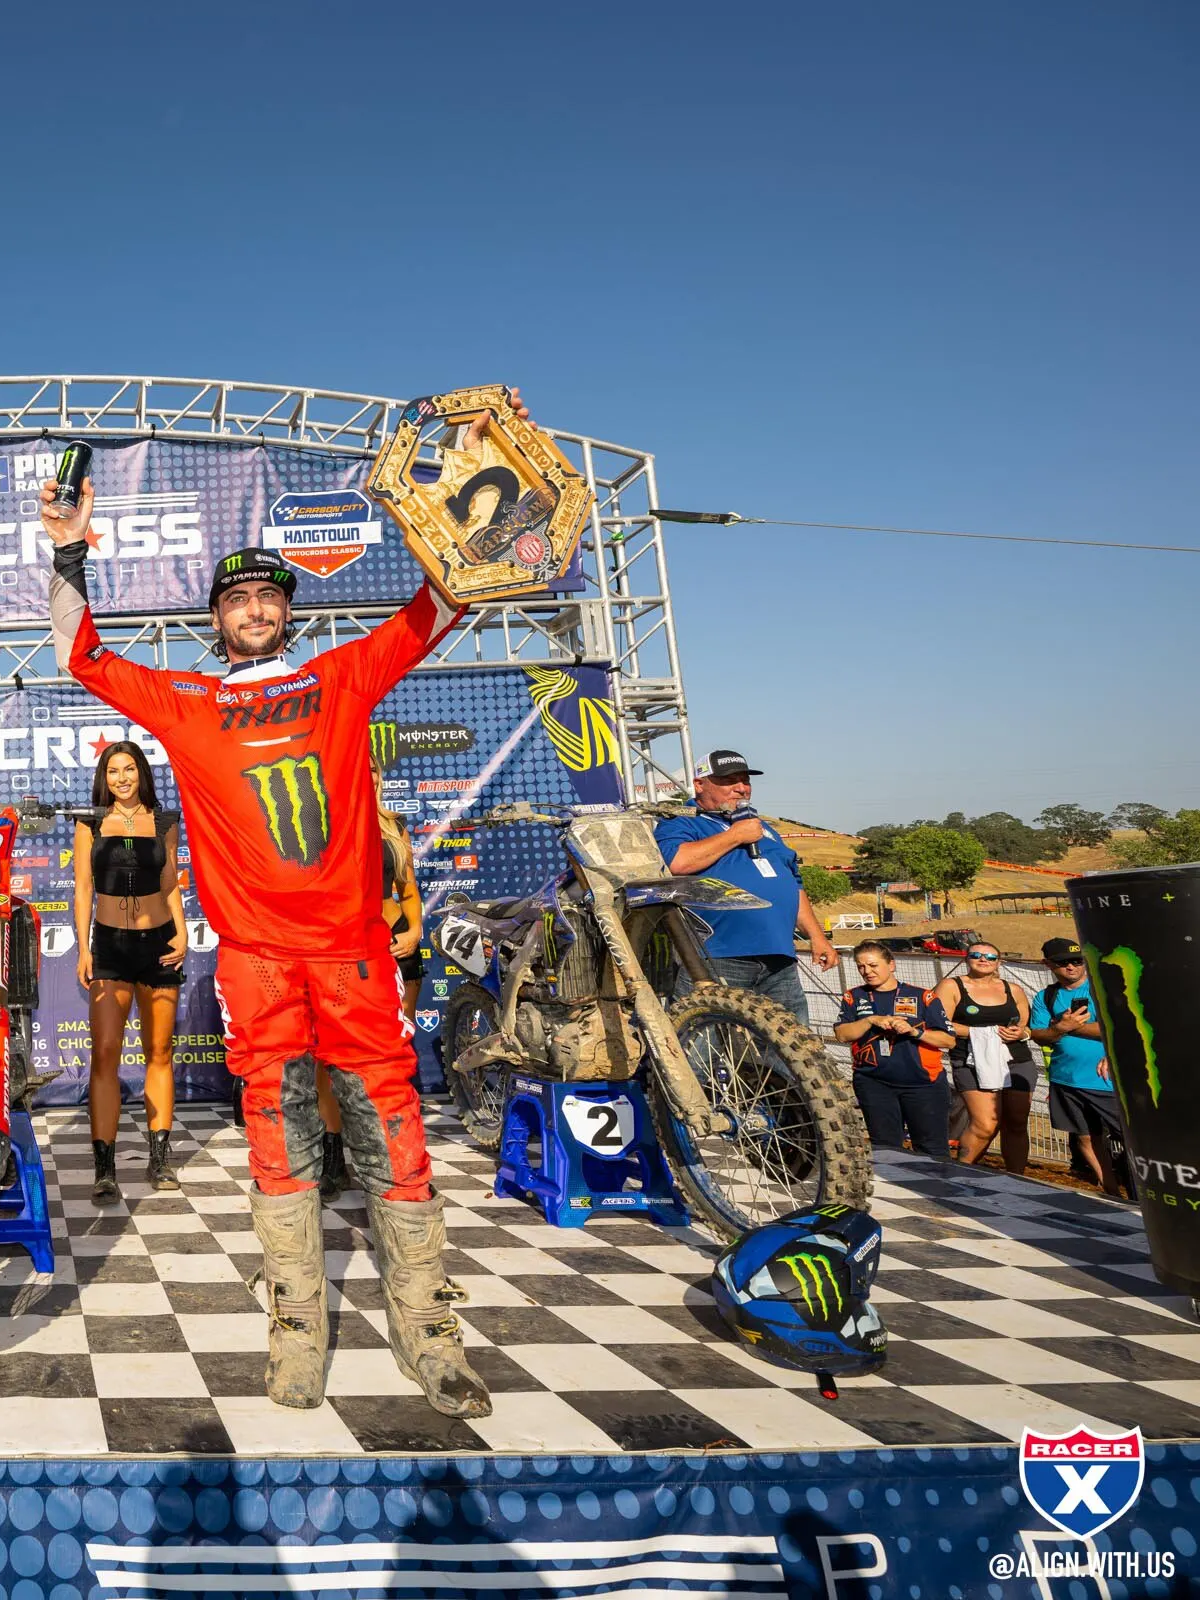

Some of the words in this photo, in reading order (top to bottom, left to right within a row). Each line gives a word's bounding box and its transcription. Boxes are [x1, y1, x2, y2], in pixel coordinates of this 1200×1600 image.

[298, 505, 341, 514] CARSON
[341, 503, 365, 512] CITY
[284, 527, 360, 544] HANGTOWN
[285, 549, 329, 557] MOTOCROSS
[331, 547, 362, 555] CLASSIC
[233, 571, 271, 582] YAMAHA
[281, 675, 317, 692] YAMAHA
[220, 688, 322, 731] THOR
[399, 729, 469, 743] MONSTER
[410, 742, 458, 750] ENERGY
[443, 838, 472, 848] THOR
[445, 925, 481, 961] 14
[438, 986, 445, 994] 2
[32, 1022, 41, 1033] 9
[422, 1017, 433, 1027] X
[33, 1039, 48, 1050] 16
[34, 1057, 50, 1068] 23
[59, 1057, 86, 1068] L.A.
[173, 1051, 226, 1064] COLISE
[586, 1105, 623, 1146] 2
